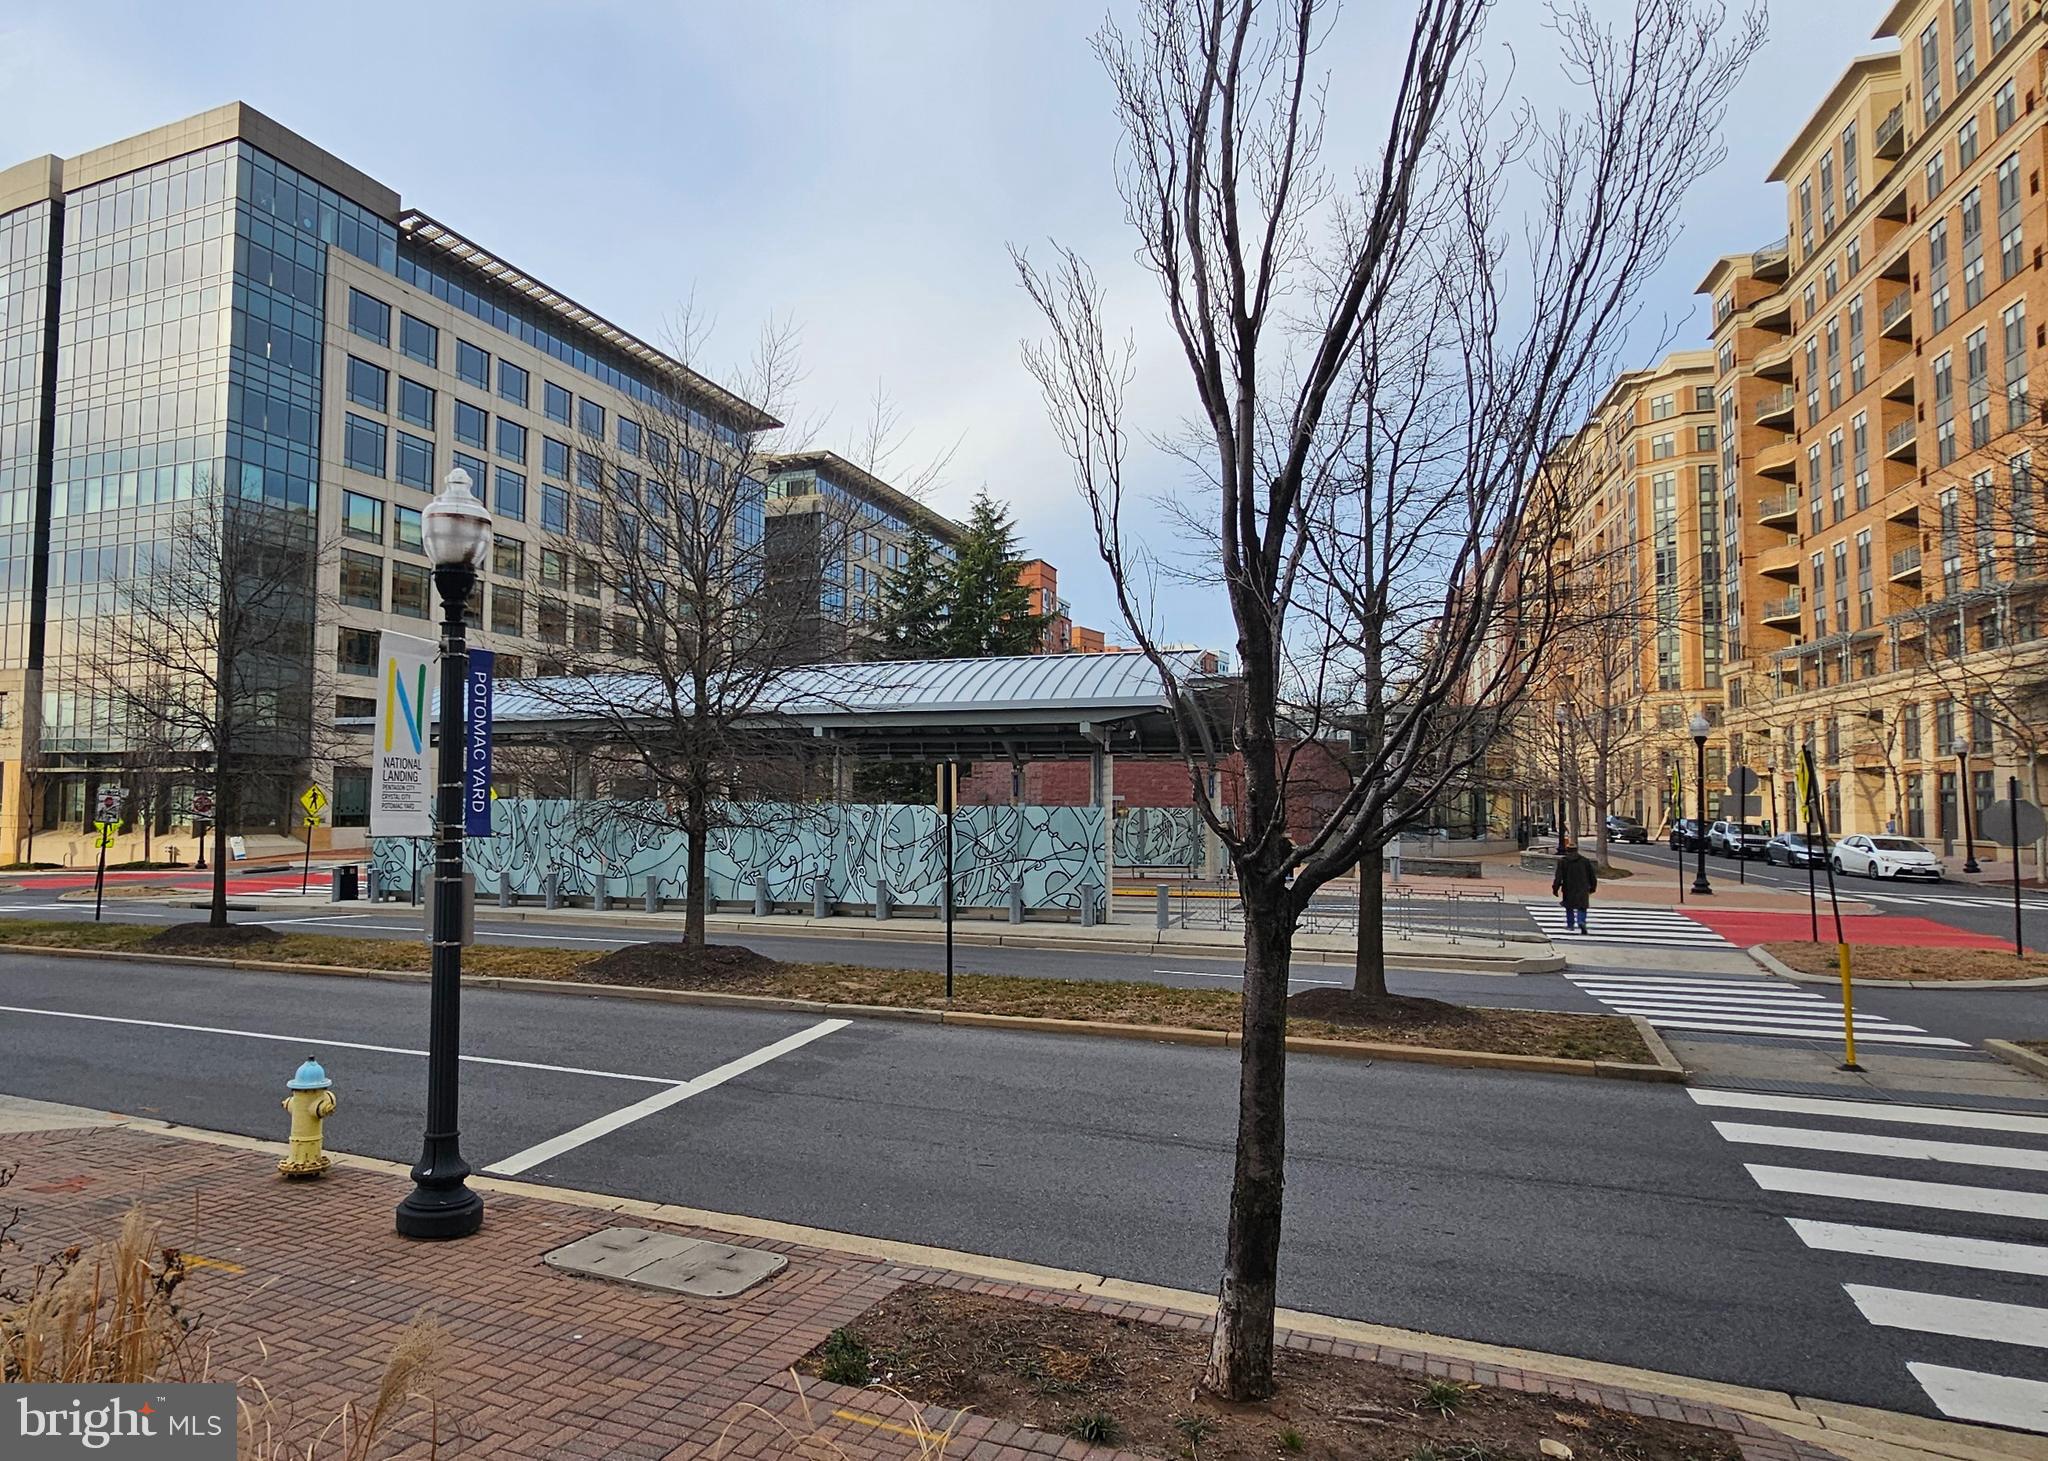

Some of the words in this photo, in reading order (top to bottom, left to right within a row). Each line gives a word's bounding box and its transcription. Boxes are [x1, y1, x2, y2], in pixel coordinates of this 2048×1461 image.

[474, 671, 487, 761] POTOMAC
[382, 770, 419, 782] LANDING
[383, 756, 422, 770] NATIONAL
[471, 765, 486, 813] YARD
